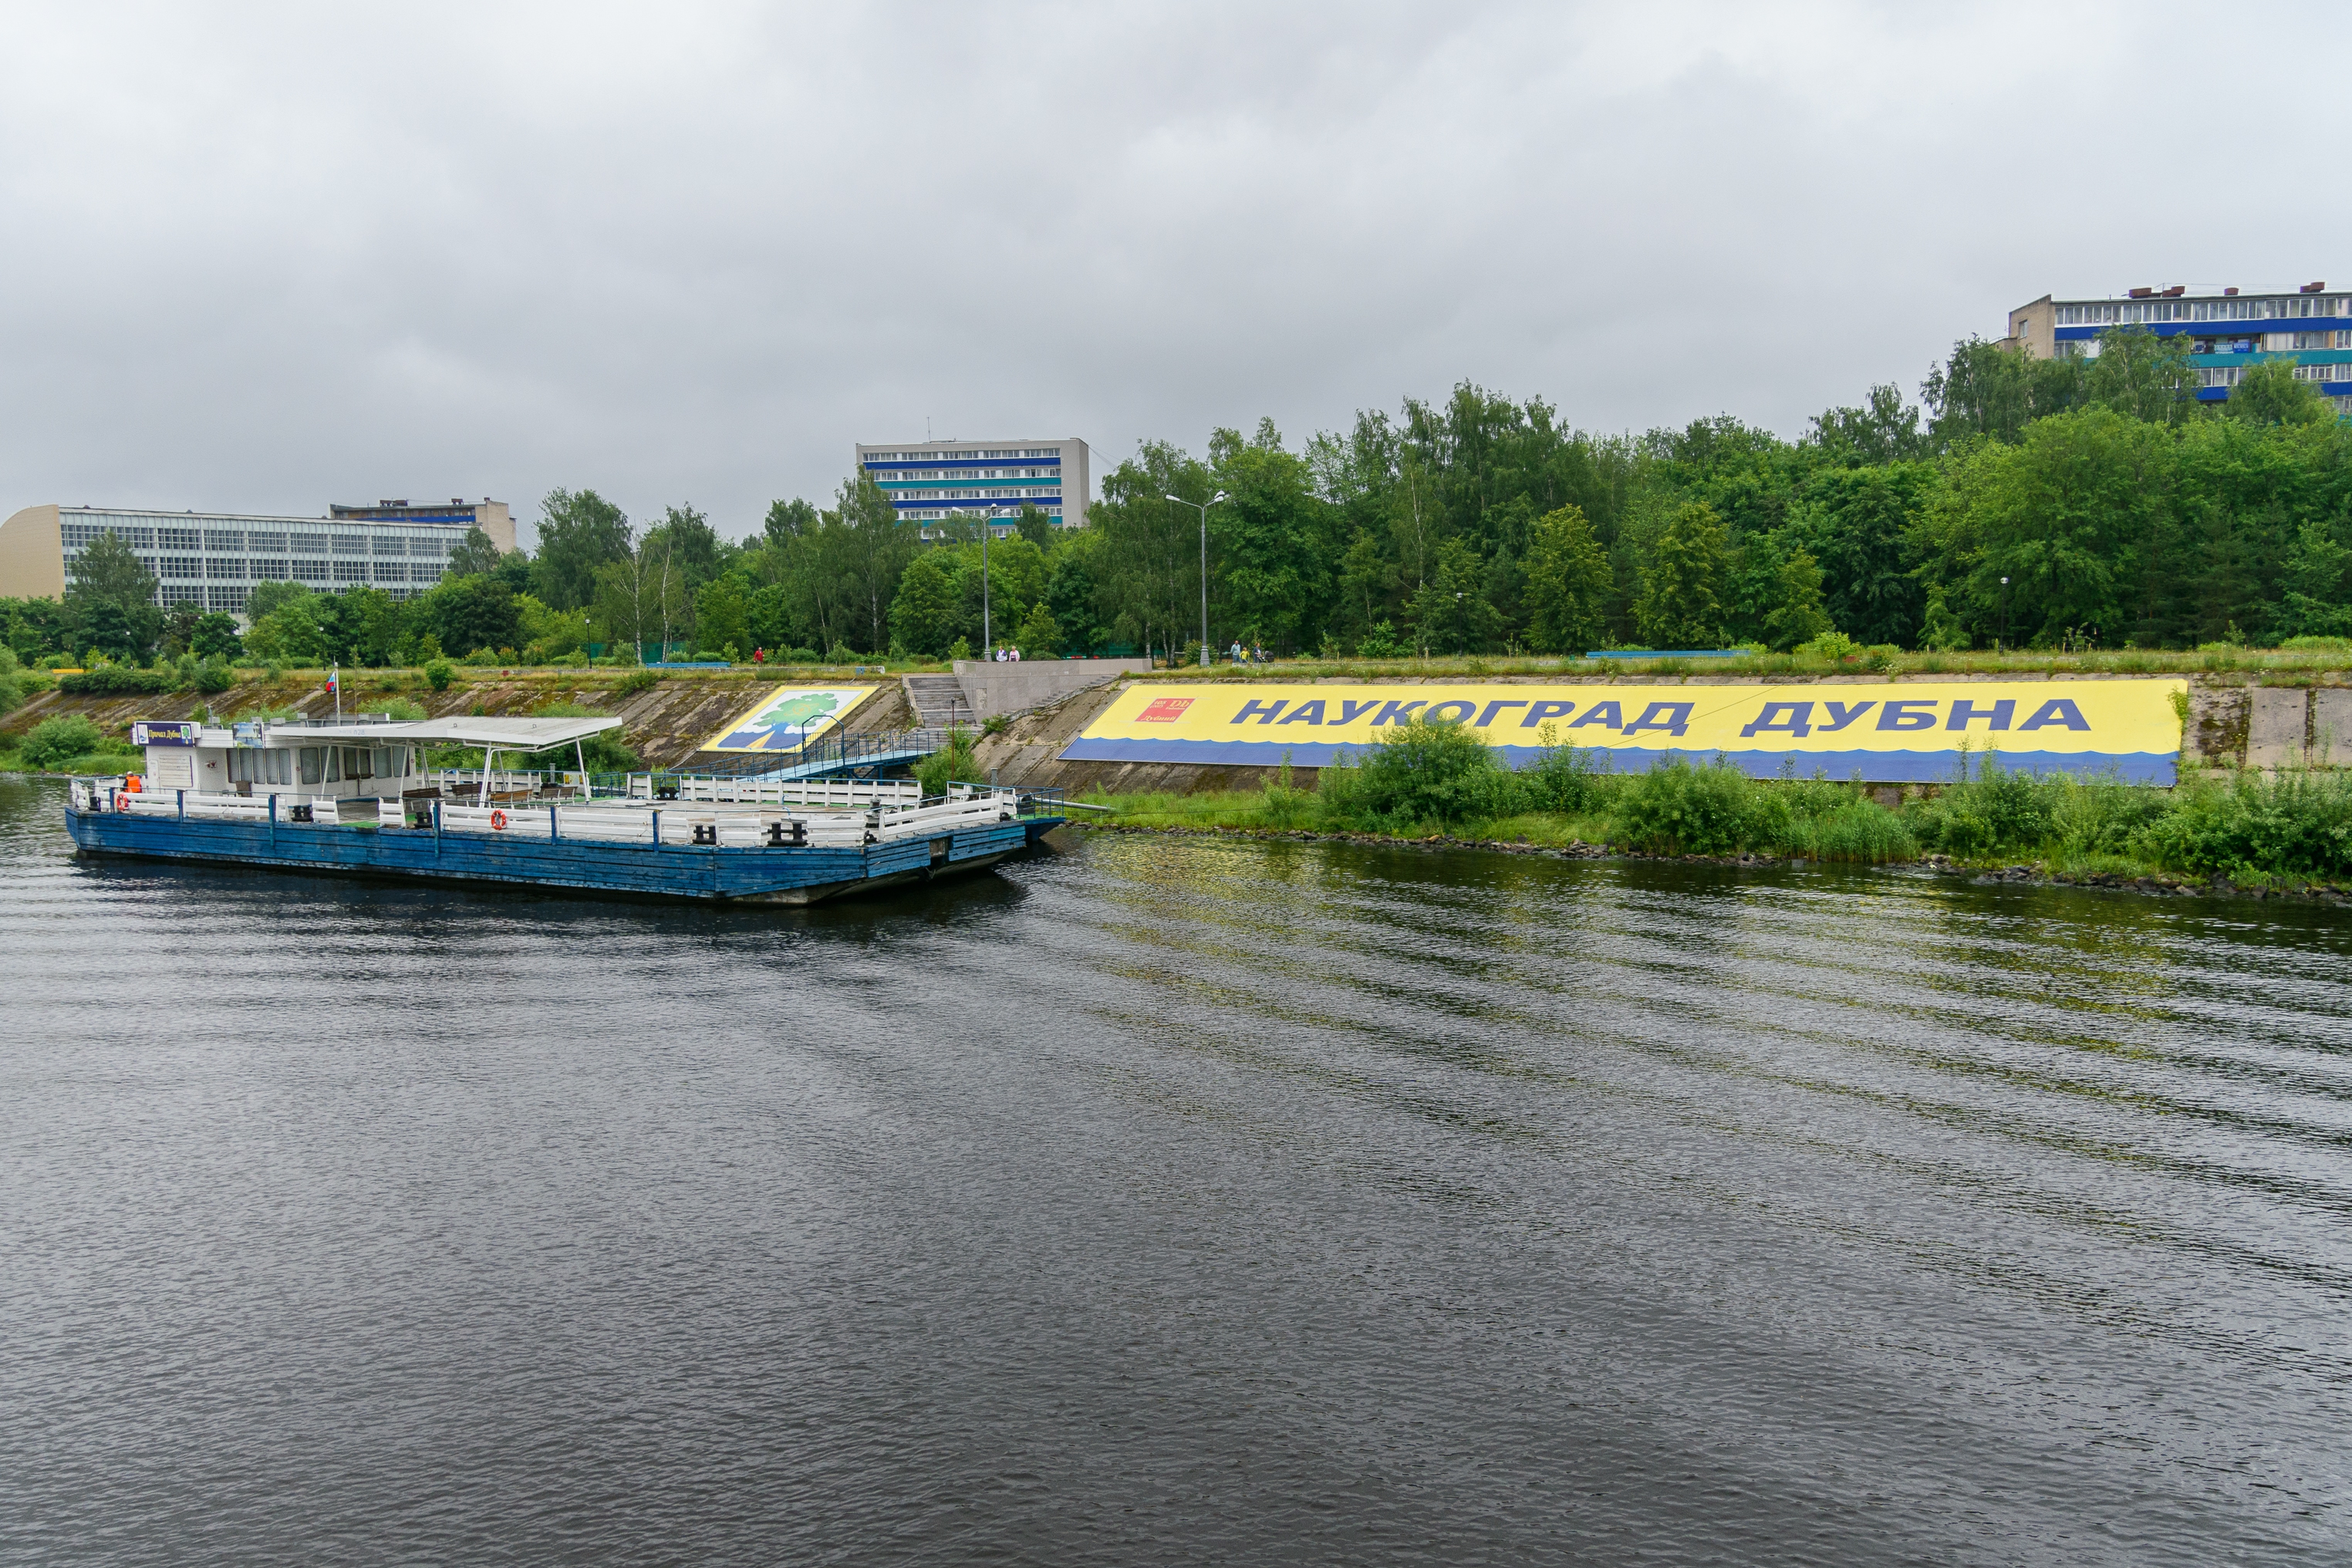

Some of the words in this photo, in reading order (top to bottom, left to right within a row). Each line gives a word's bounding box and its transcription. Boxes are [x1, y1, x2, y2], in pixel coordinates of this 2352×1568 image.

[1229, 699, 1695, 737] НАУКОГРАД
[1739, 699, 2091, 737] ДУБНА
[149, 730, 166, 740] Причал
[167, 730, 181, 740] Дубна
